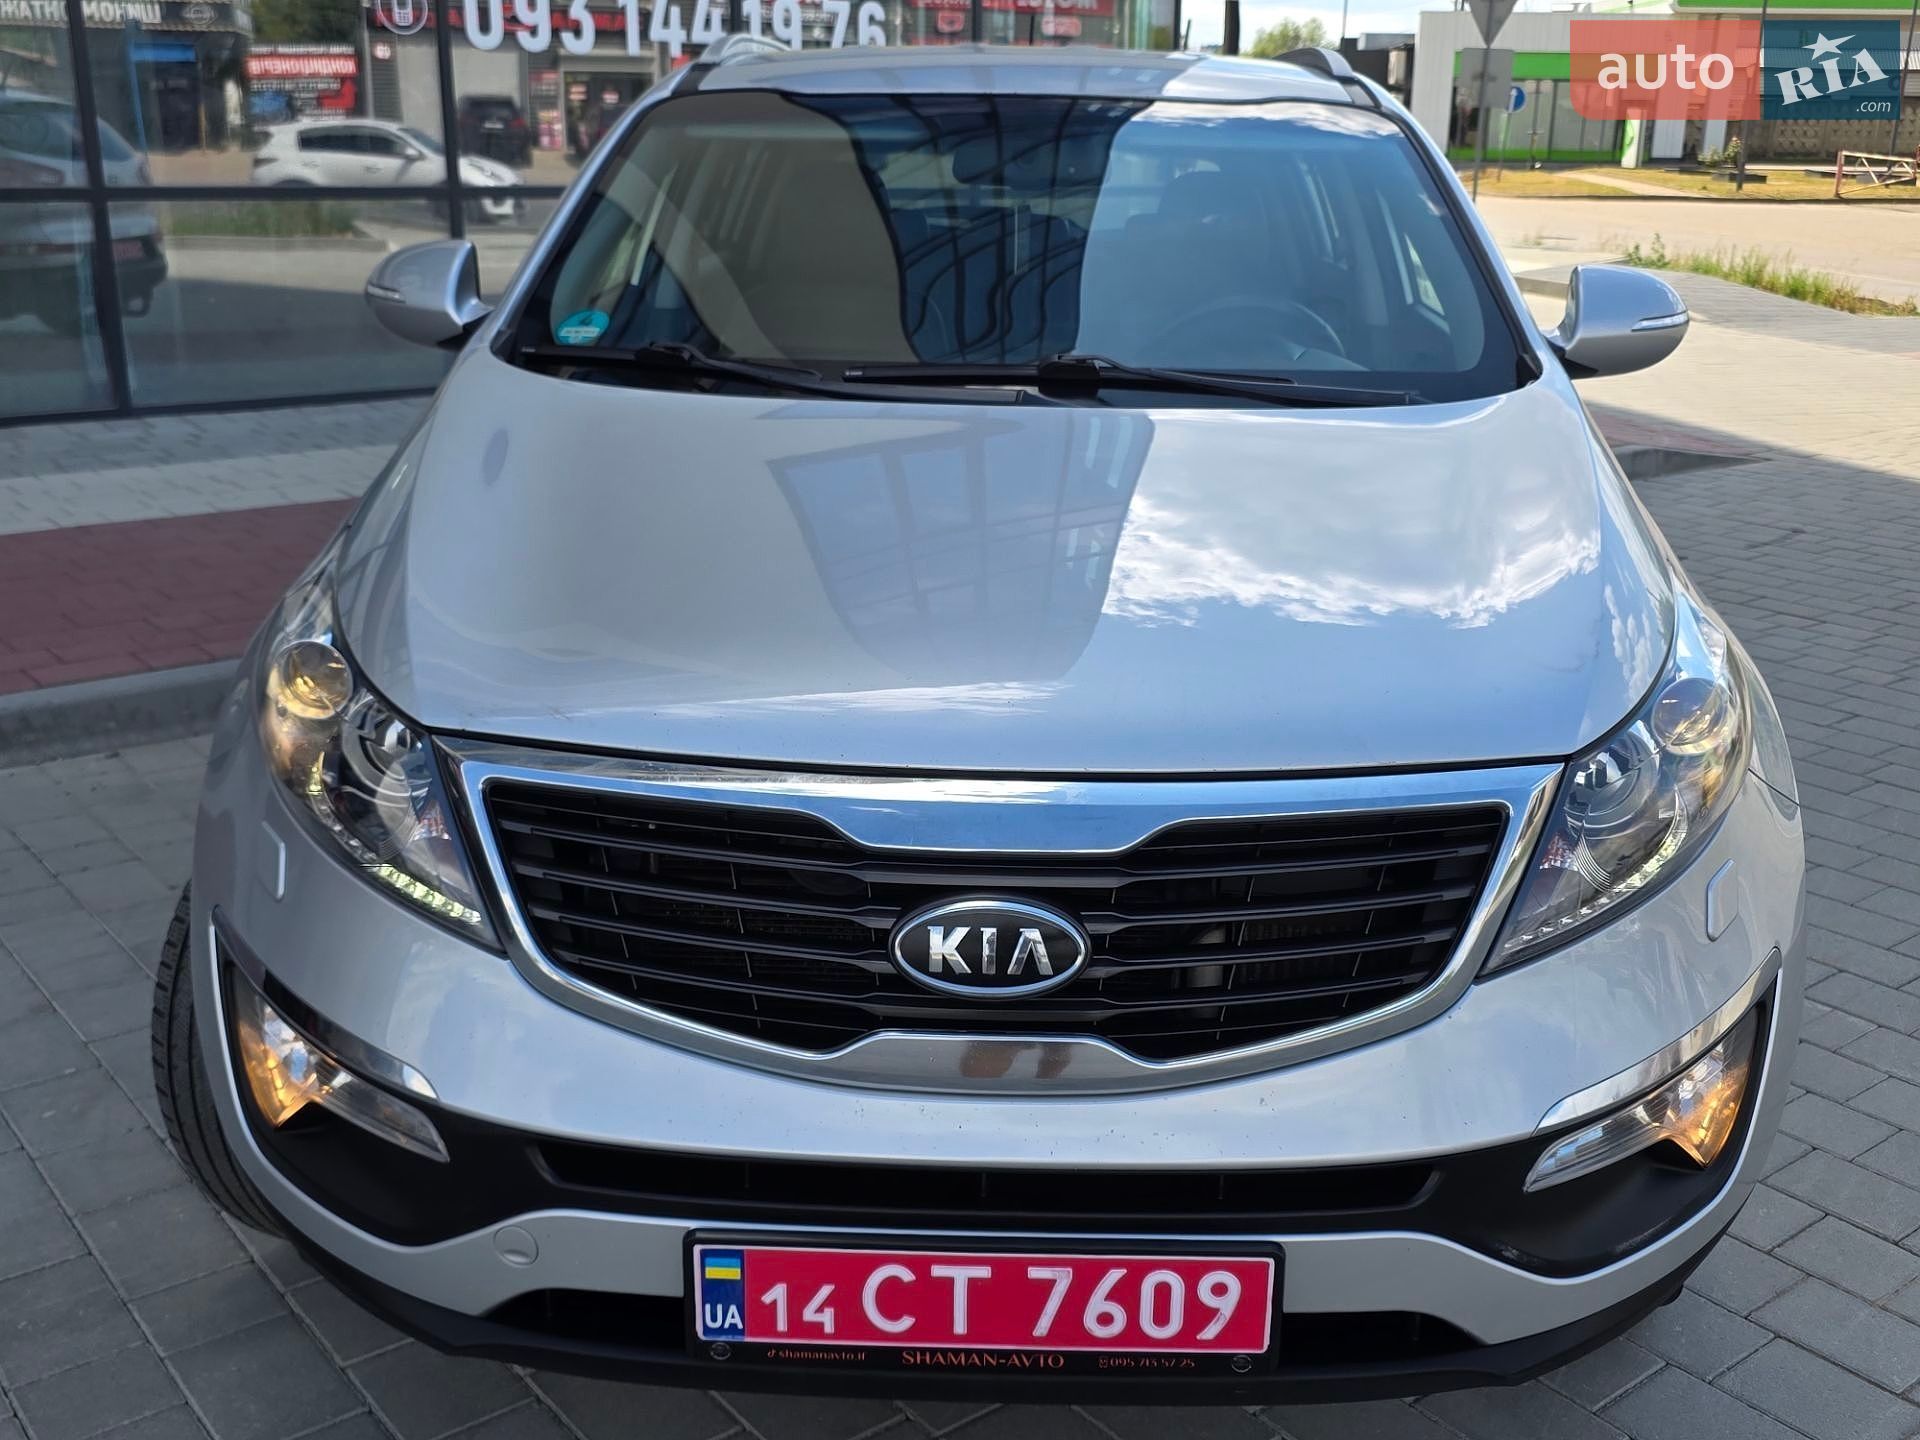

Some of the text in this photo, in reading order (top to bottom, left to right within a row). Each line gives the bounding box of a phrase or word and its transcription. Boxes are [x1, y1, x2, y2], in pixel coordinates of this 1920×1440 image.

[464, 0, 596, 55] 093
[617, 0, 727, 58] 144
[742, 0, 802, 50] 19
[822, 1, 887, 49] 76
[927, 926, 1054, 975] KIA
[704, 1303, 743, 1330] UA
[760, 1263, 1242, 1341] 14 CT 7609
[901, 1350, 1065, 1369] SHAMAN-AVTO
[1110, 1357, 1134, 1368] 095
[1179, 1358, 1195, 1368] 25
